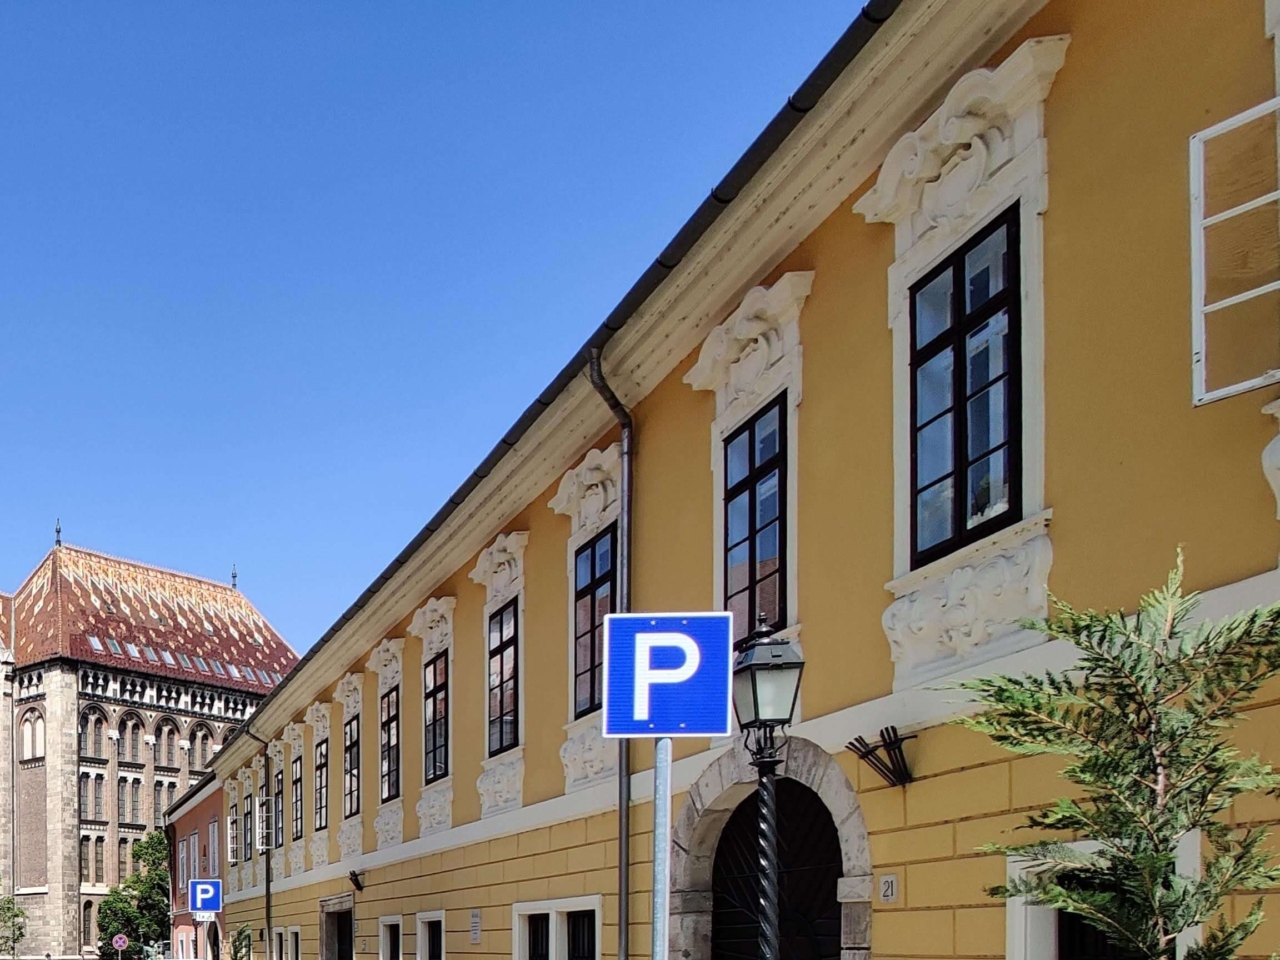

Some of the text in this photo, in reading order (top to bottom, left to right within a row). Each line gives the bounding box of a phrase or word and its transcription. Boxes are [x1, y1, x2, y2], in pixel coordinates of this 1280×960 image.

[633, 632, 700, 721] P
[196, 884, 214, 908] P
[882, 880, 894, 897] 21
